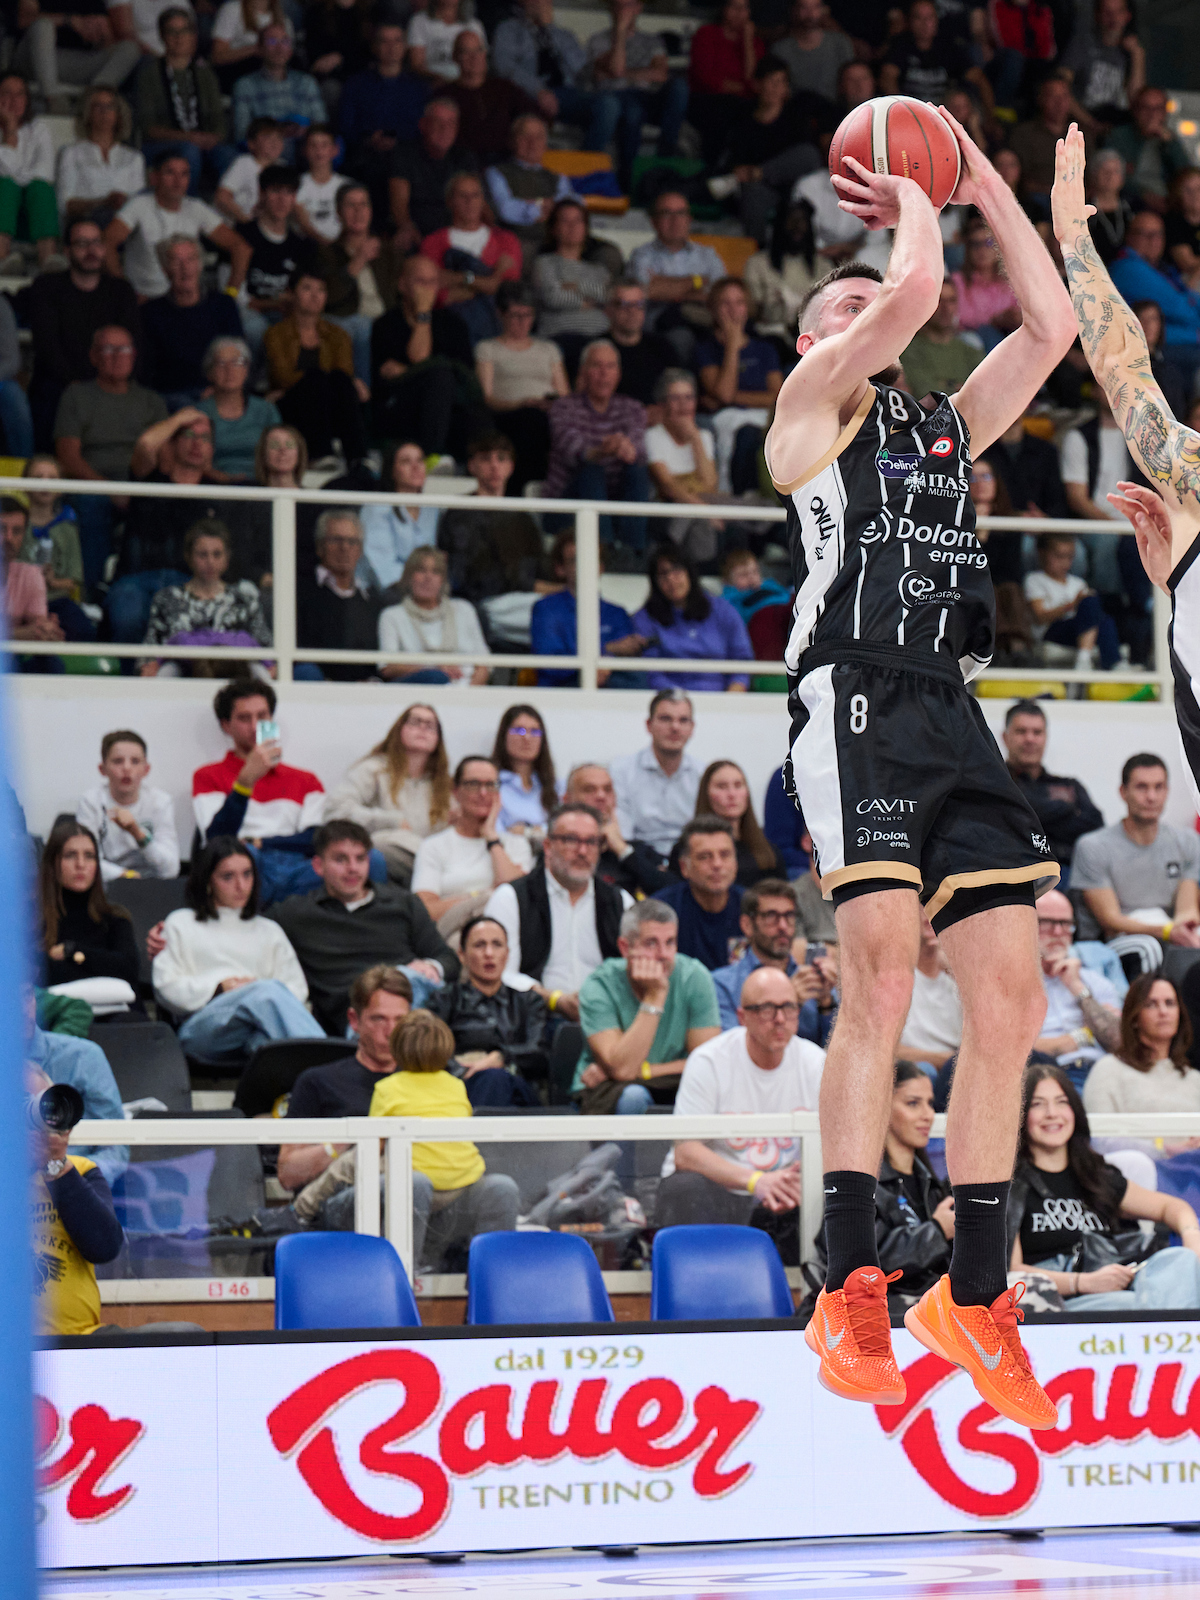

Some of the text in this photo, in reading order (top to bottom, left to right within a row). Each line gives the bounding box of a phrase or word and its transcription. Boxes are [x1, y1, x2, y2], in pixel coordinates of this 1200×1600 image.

[888, 390, 909, 422] 8
[928, 473, 970, 492] ITAS
[928, 488, 960, 498] MUTUA
[850, 693, 869, 735] 8
[855, 798, 918, 815] CAVIT
[228, 1281, 250, 1297] 46
[1080, 1334, 1124, 1355] dal
[494, 1346, 645, 1371] dal 1929
[267, 1349, 763, 1543] Bauer
[472, 1479, 675, 1509] TRENTINO
